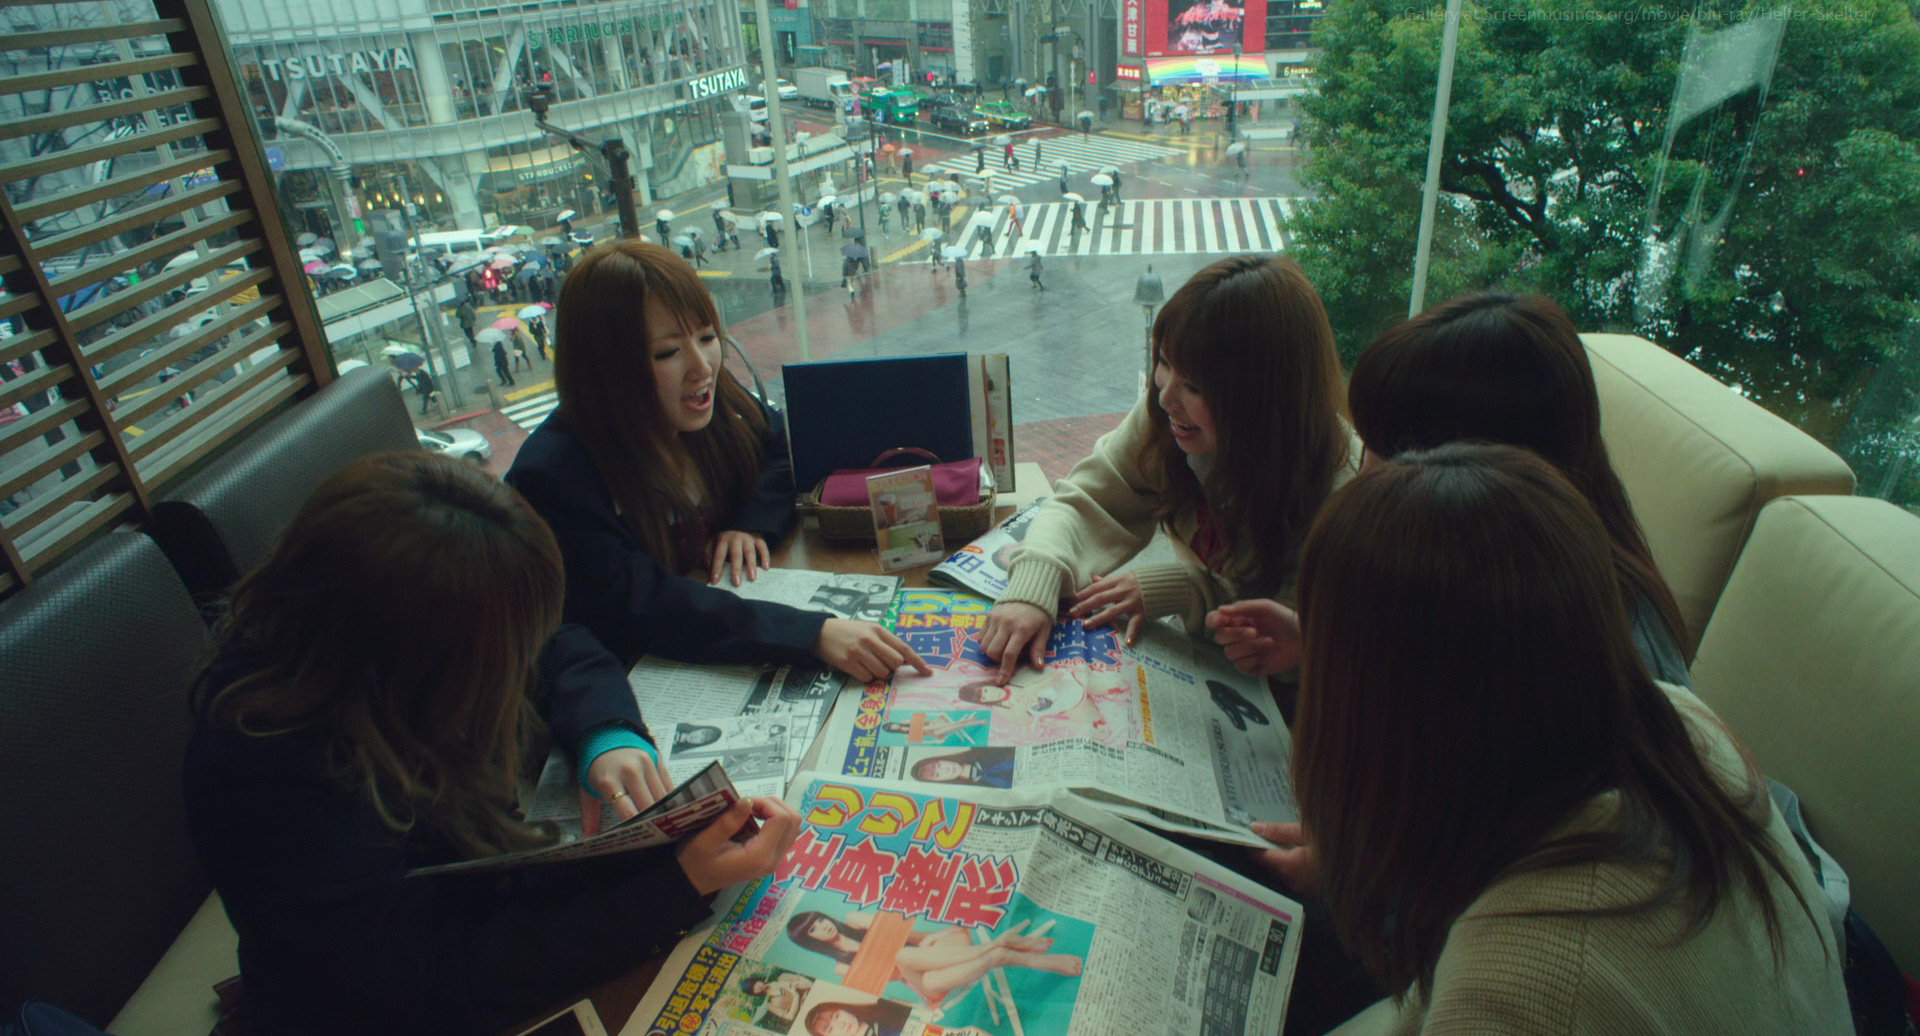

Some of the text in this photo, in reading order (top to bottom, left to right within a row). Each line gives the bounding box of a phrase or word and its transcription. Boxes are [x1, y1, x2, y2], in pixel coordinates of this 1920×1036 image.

[263, 47, 413, 82] TSUTAYA
[689, 68, 746, 99] TSUTAYA
[806, 783, 977, 849] りりこ
[771, 824, 1021, 930] 全身整形
